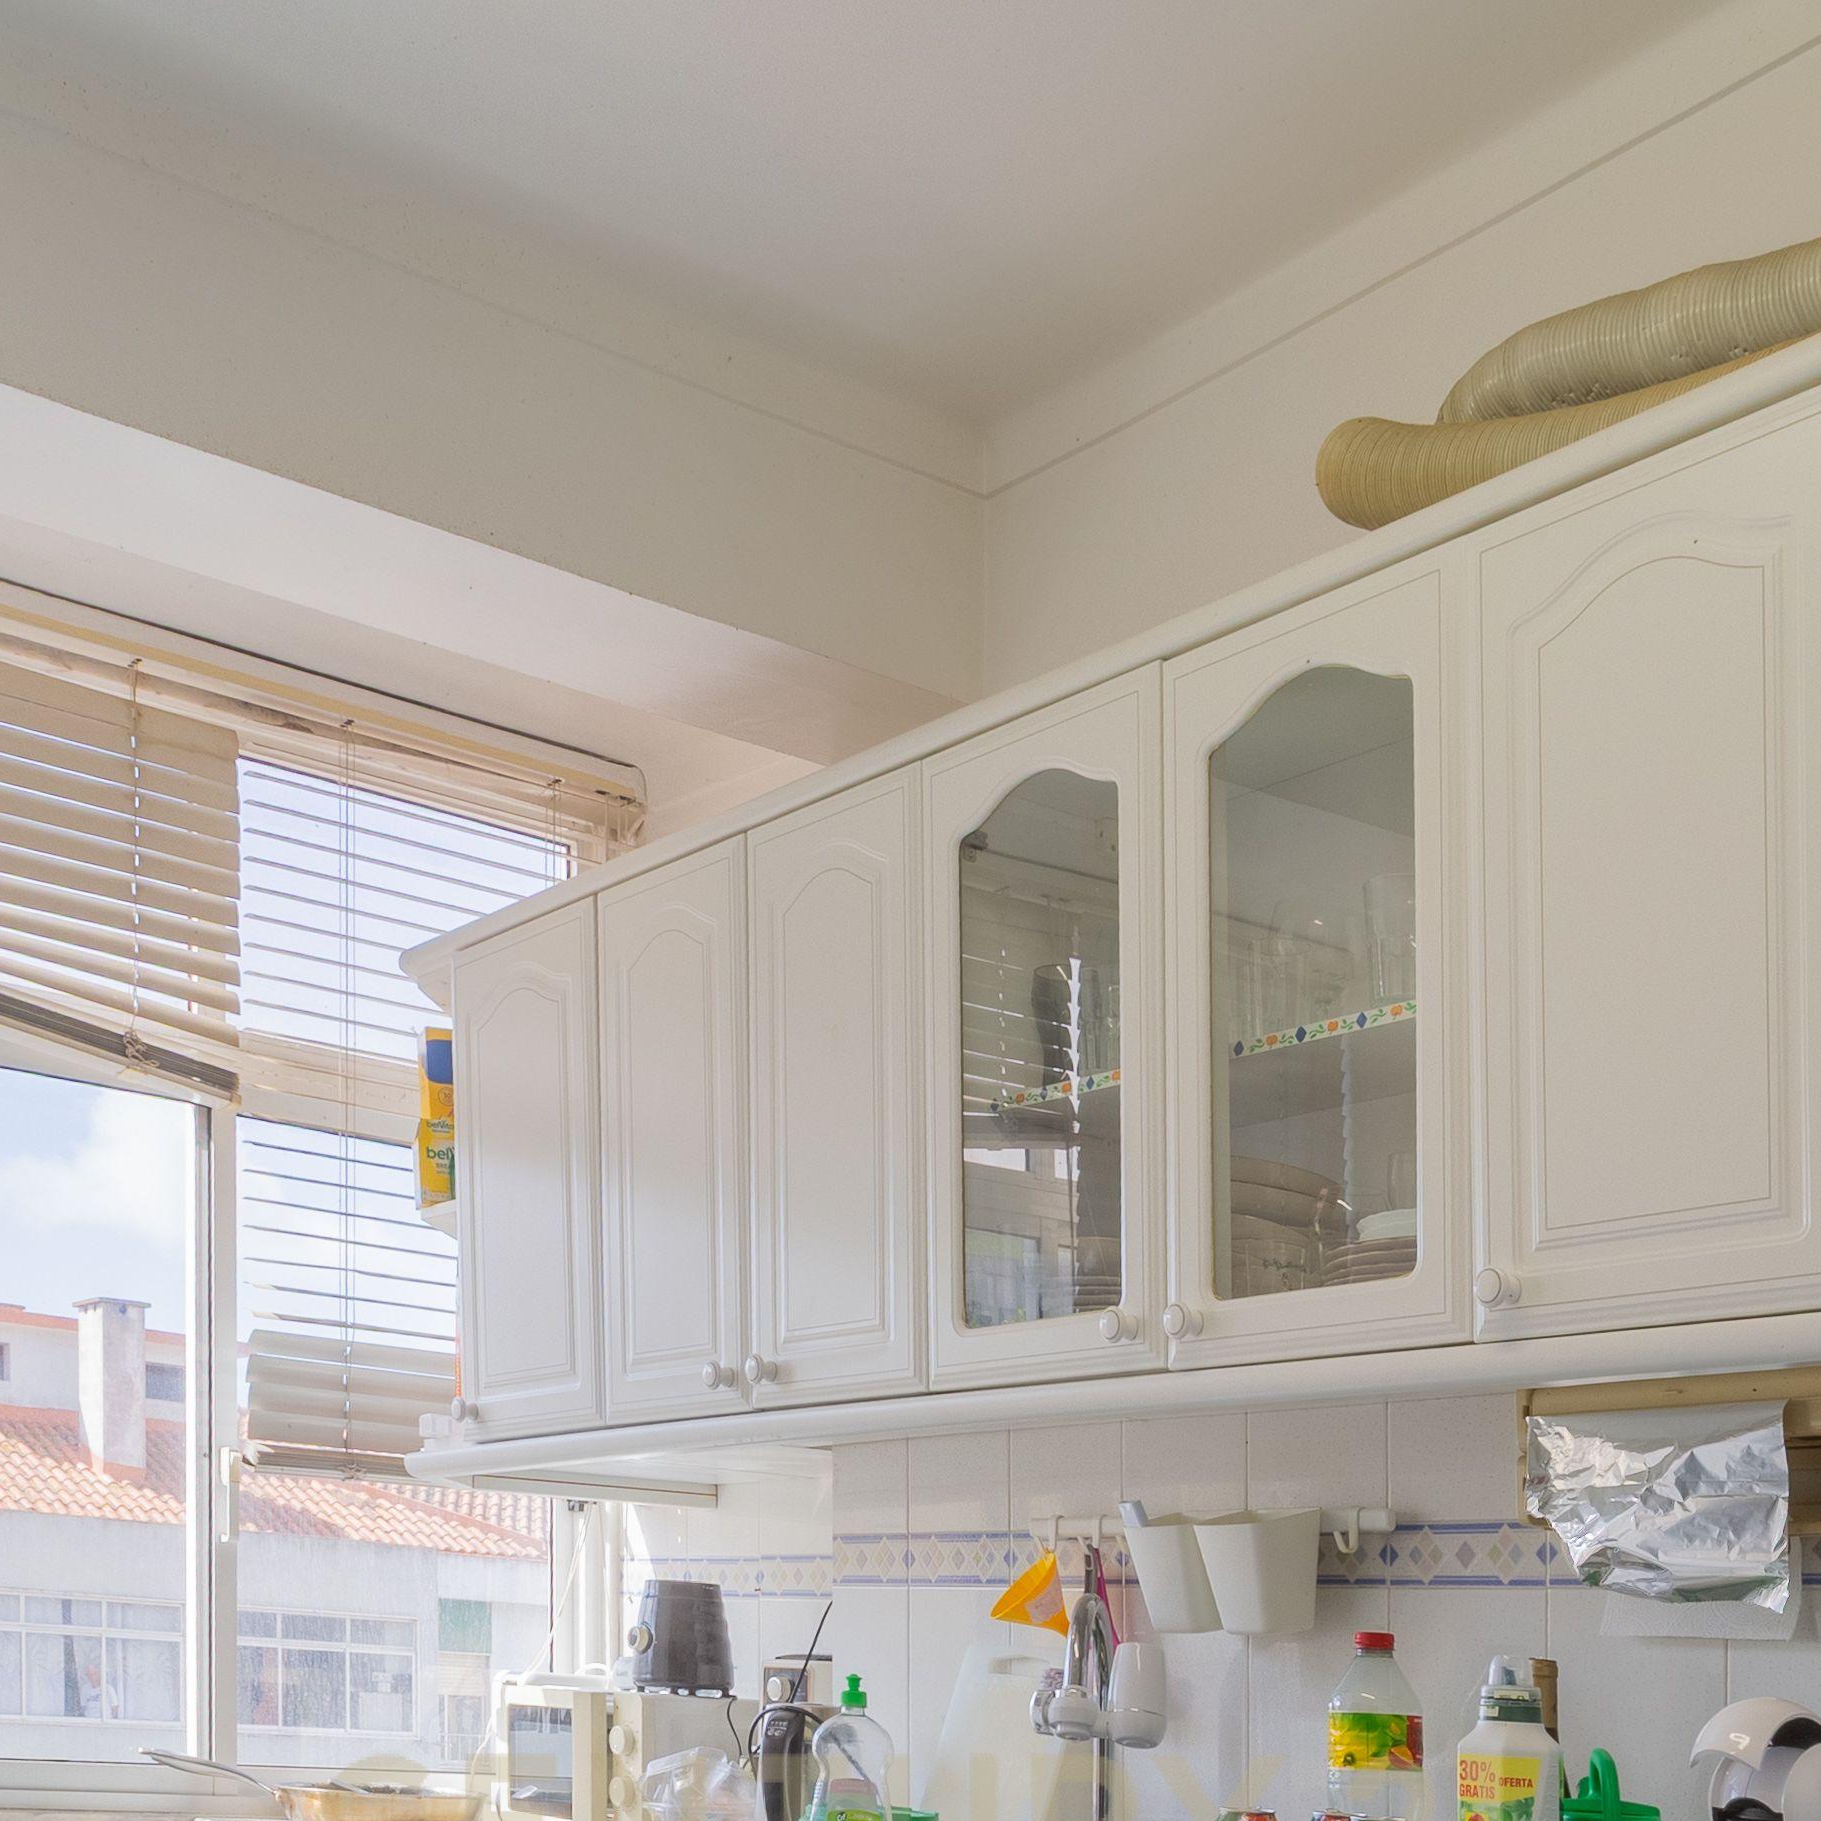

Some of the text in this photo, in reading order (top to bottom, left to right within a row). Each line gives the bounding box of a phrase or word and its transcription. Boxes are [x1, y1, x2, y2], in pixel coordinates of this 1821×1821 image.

[1459, 1759, 1497, 1783] 30%
[1459, 1776, 1534, 1800] GRATIS OFERTA
